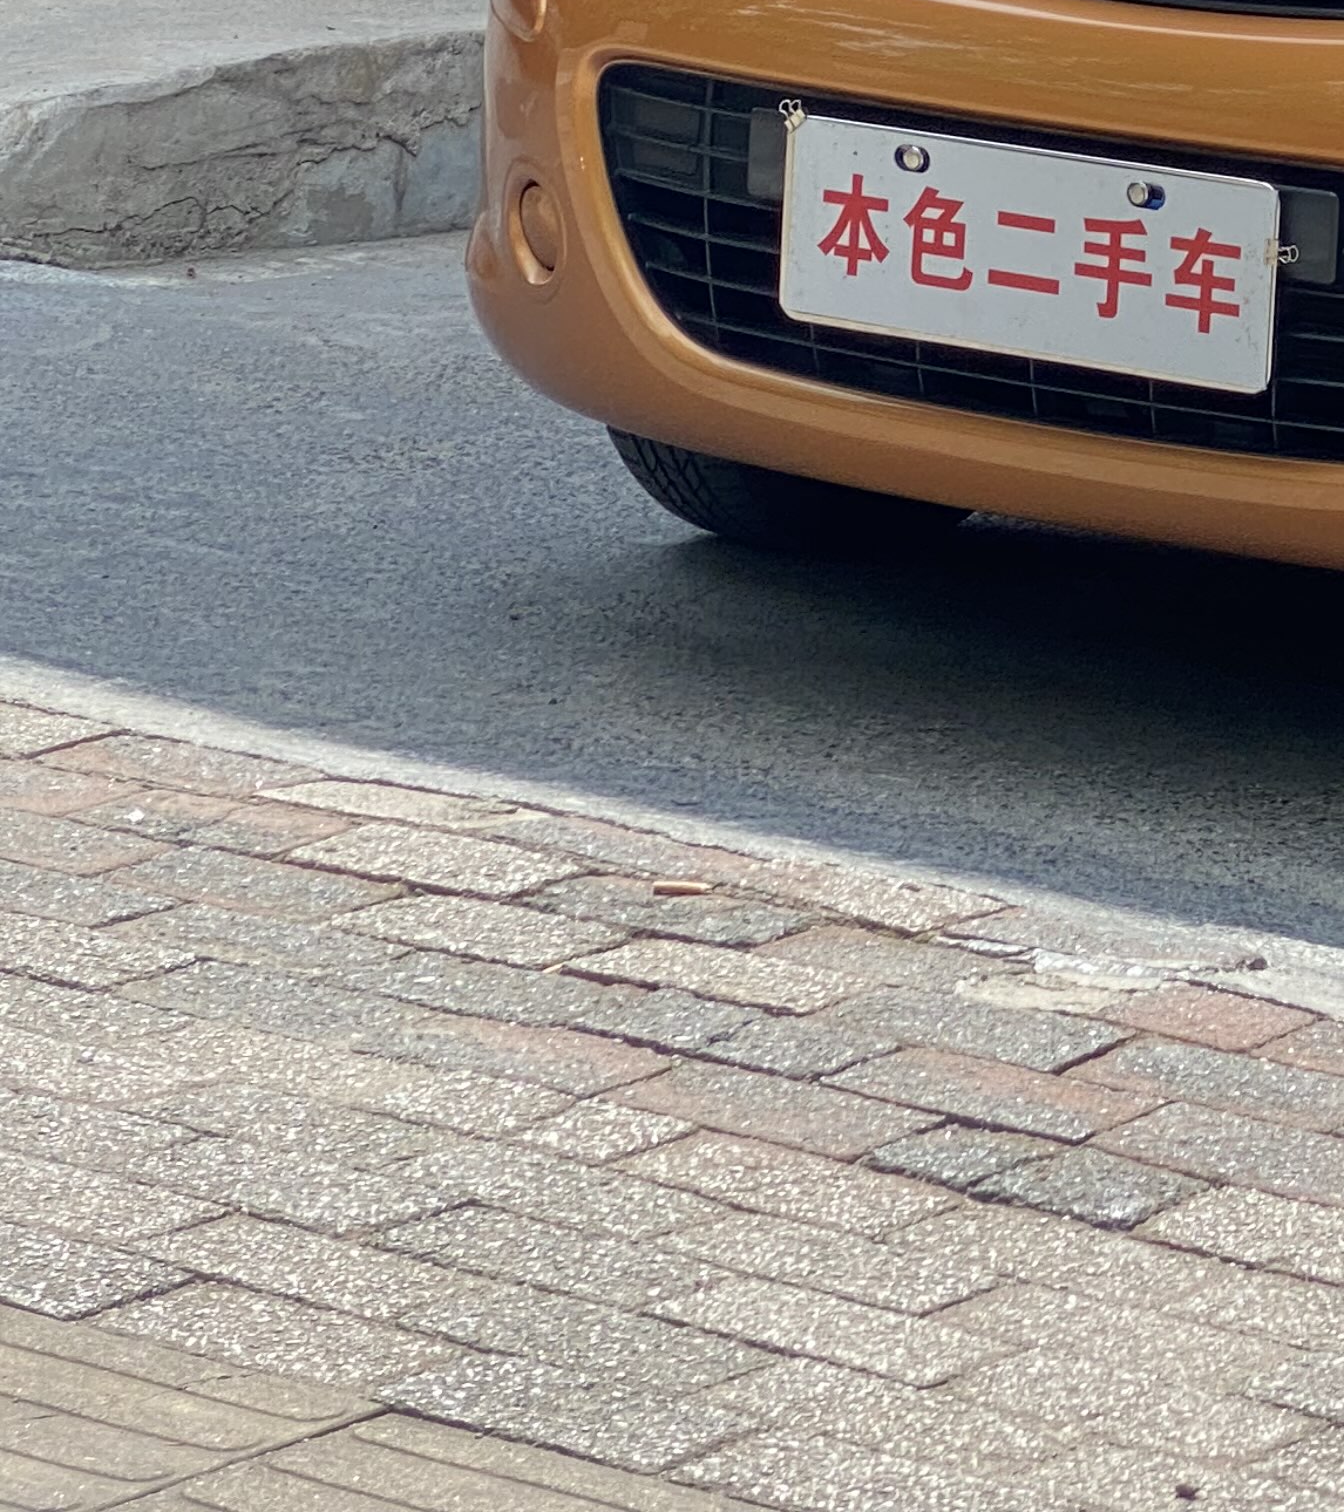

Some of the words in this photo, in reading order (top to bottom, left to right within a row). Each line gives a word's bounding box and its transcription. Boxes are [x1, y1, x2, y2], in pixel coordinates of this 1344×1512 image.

[817, 173, 1242, 334] 本色二手车
